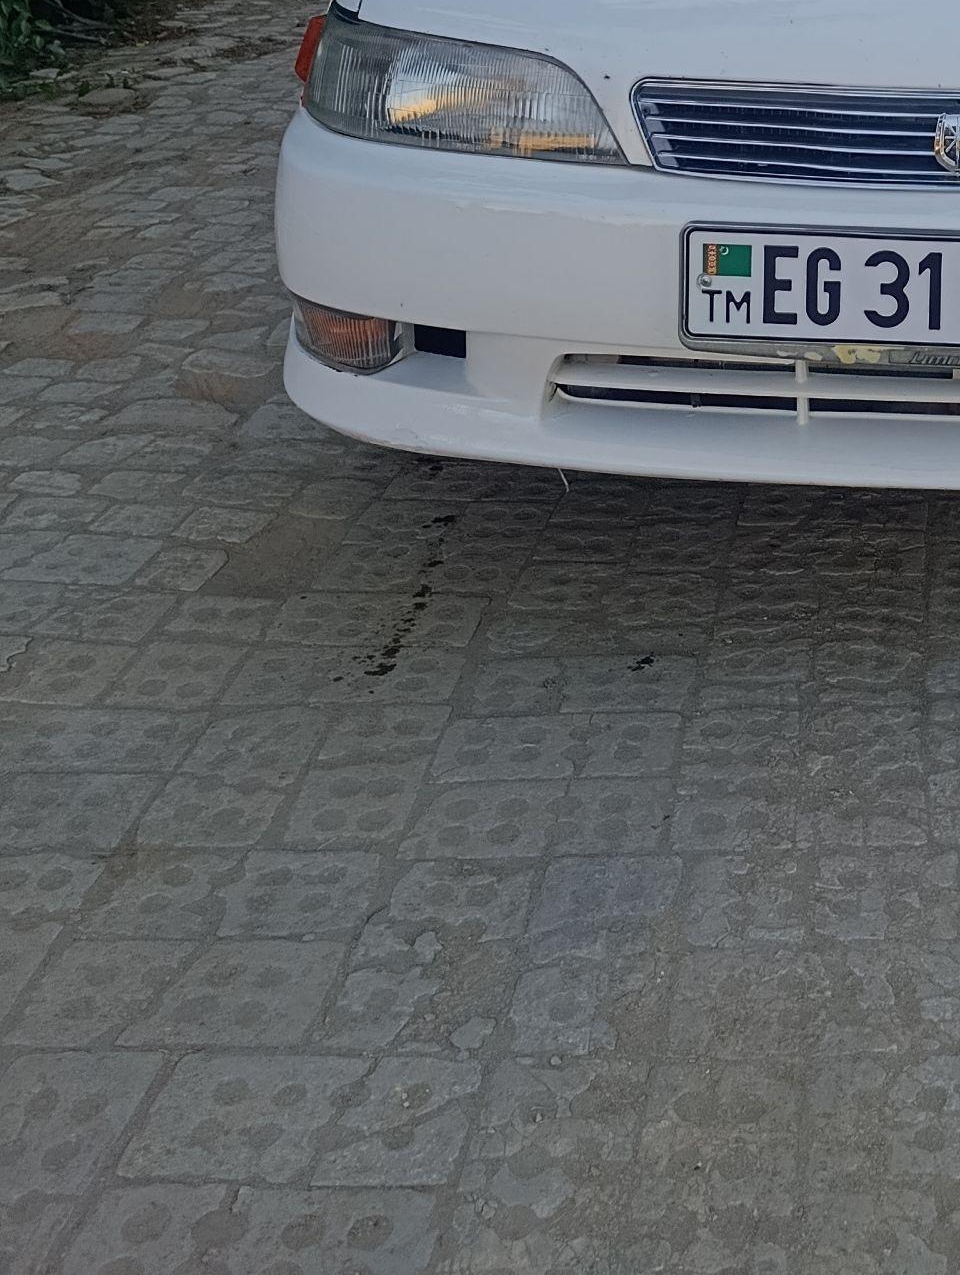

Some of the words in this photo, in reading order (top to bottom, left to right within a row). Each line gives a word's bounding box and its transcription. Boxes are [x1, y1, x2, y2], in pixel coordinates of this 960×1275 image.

[701, 288, 752, 325] TM
[762, 244, 842, 327] EG
[863, 250, 943, 331] 31
